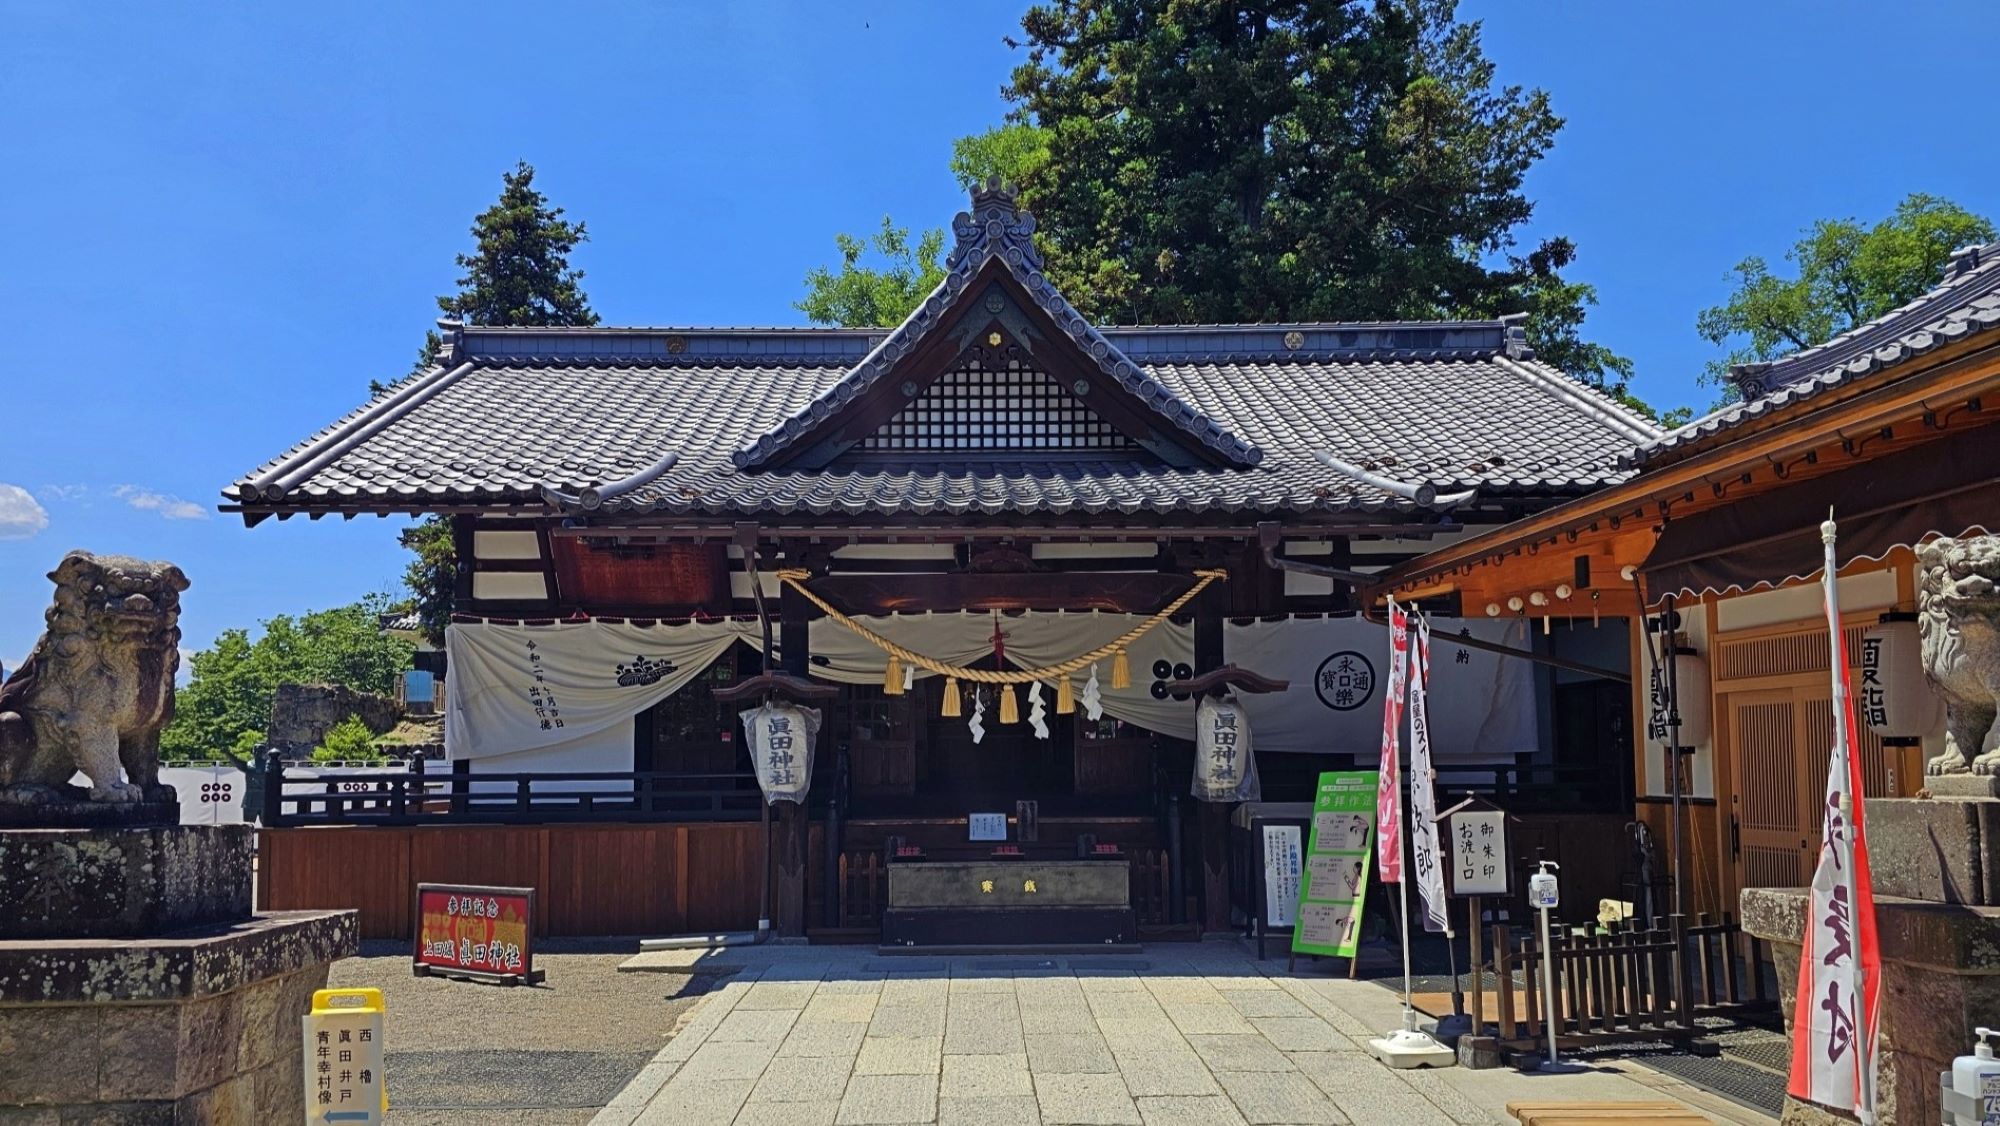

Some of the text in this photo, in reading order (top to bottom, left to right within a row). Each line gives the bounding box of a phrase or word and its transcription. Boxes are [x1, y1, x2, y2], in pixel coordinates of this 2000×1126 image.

[768, 717, 797, 785] 眞田神社
[1211, 712, 1239, 780] 眞田神社
[1320, 795, 1372, 806] 参拝作法
[1460, 822, 1475, 880] お渡し口
[1481, 822, 1495, 879] 御朱印
[447, 896, 499, 917] 参拝記念
[423, 938, 455, 961] 上田城
[316, 1031, 332, 1105] 青年幸村像
[339, 1029, 352, 1103] 眞田井戸
